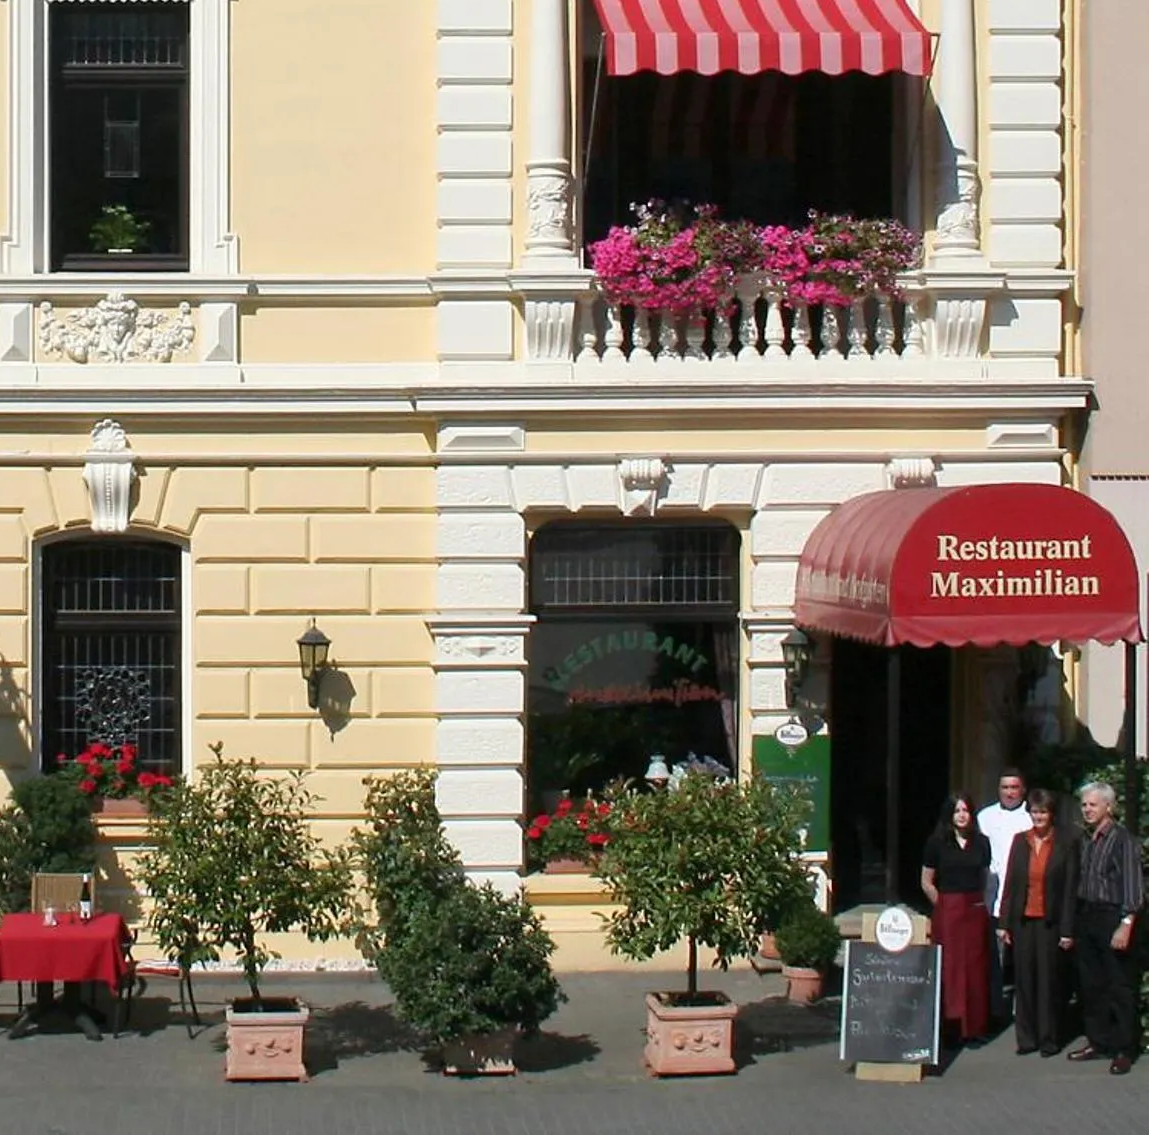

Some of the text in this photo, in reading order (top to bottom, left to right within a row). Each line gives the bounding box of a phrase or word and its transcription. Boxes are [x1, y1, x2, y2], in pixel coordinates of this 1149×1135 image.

[936, 534, 1092, 561] Restaurant
[930, 568, 1100, 598] Maximilian
[542, 630, 708, 692] RESTAURANT
